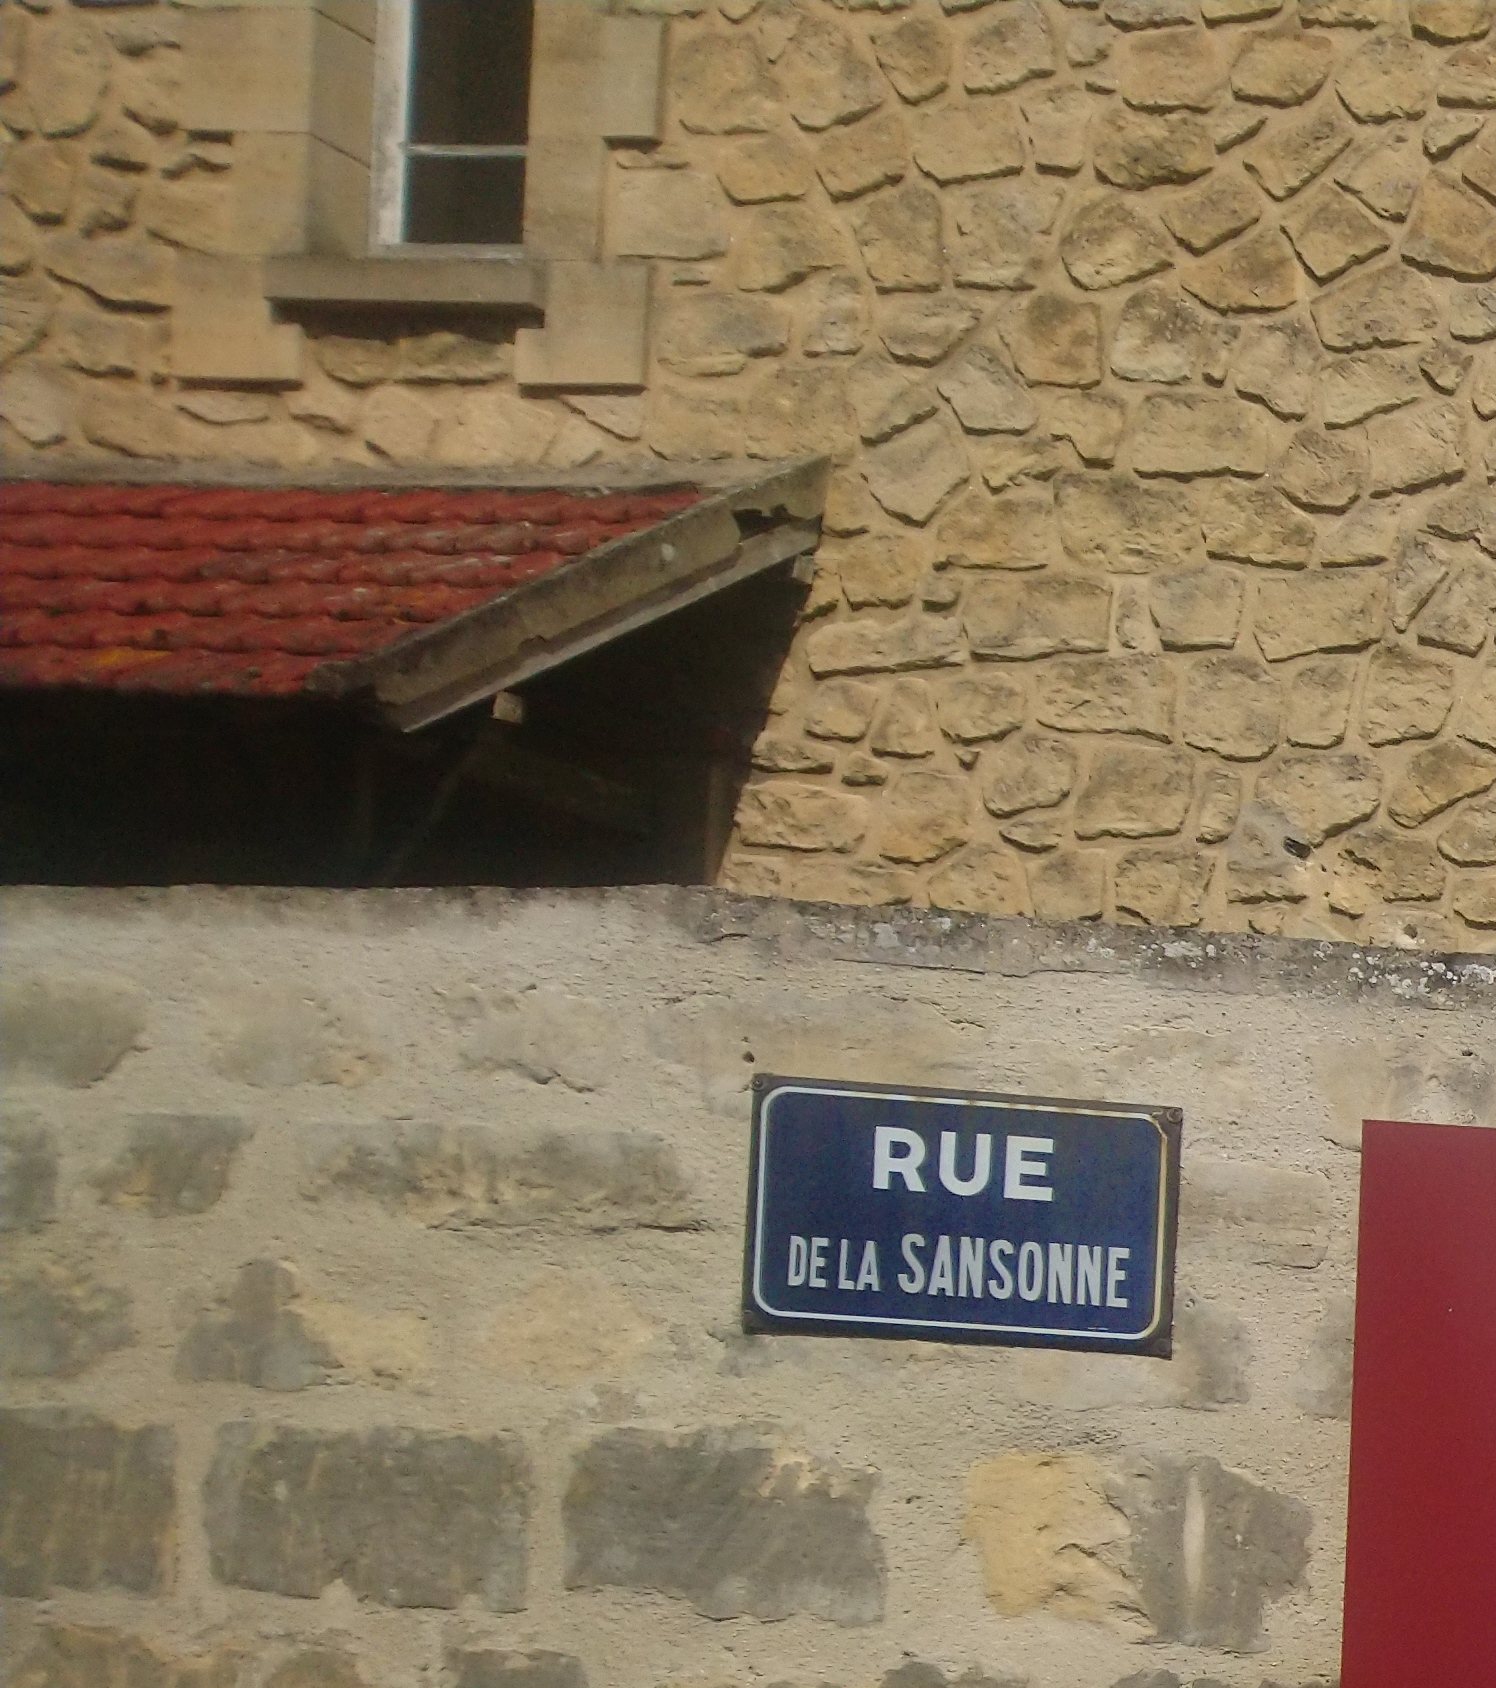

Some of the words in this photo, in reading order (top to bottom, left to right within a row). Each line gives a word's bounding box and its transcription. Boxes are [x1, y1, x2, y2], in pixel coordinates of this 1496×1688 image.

[873, 1126, 1054, 1201] RUE
[787, 1235, 829, 1289] DE
[838, 1237, 881, 1292] LA
[898, 1233, 1130, 1309] SANSONNE
